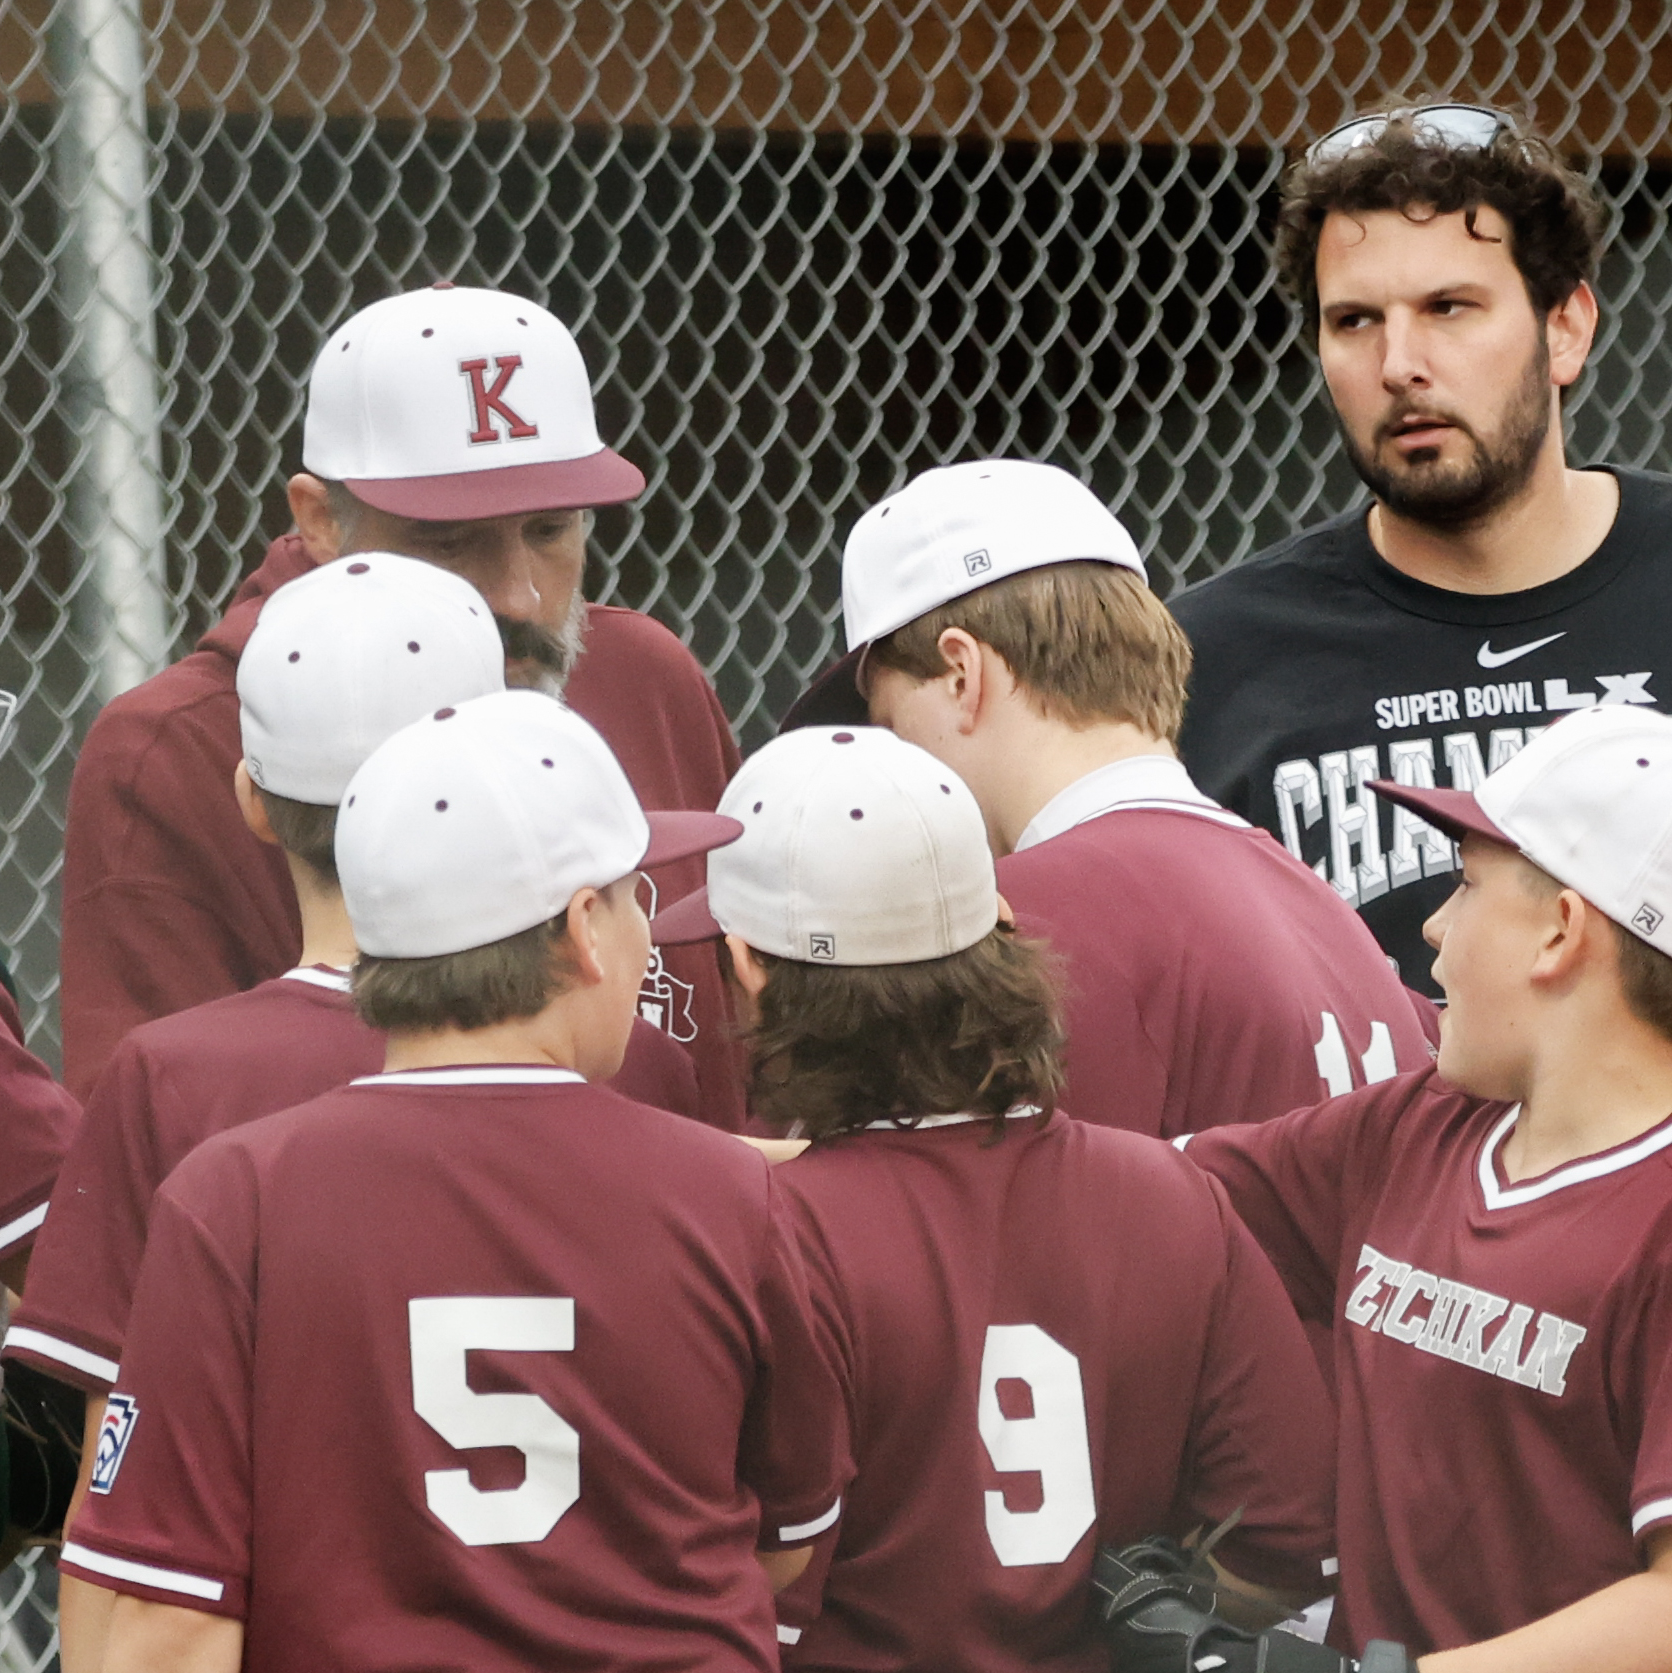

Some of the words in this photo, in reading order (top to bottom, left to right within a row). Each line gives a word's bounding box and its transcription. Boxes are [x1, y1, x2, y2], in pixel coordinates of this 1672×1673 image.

[458, 352, 539, 446] K
[1375, 688, 1460, 730] SUPER
[1464, 681, 1542, 718] BOWL
[1543, 672, 1658, 711] LX
[408, 1297, 580, 1547] 5
[979, 1324, 1097, 1567] 9
